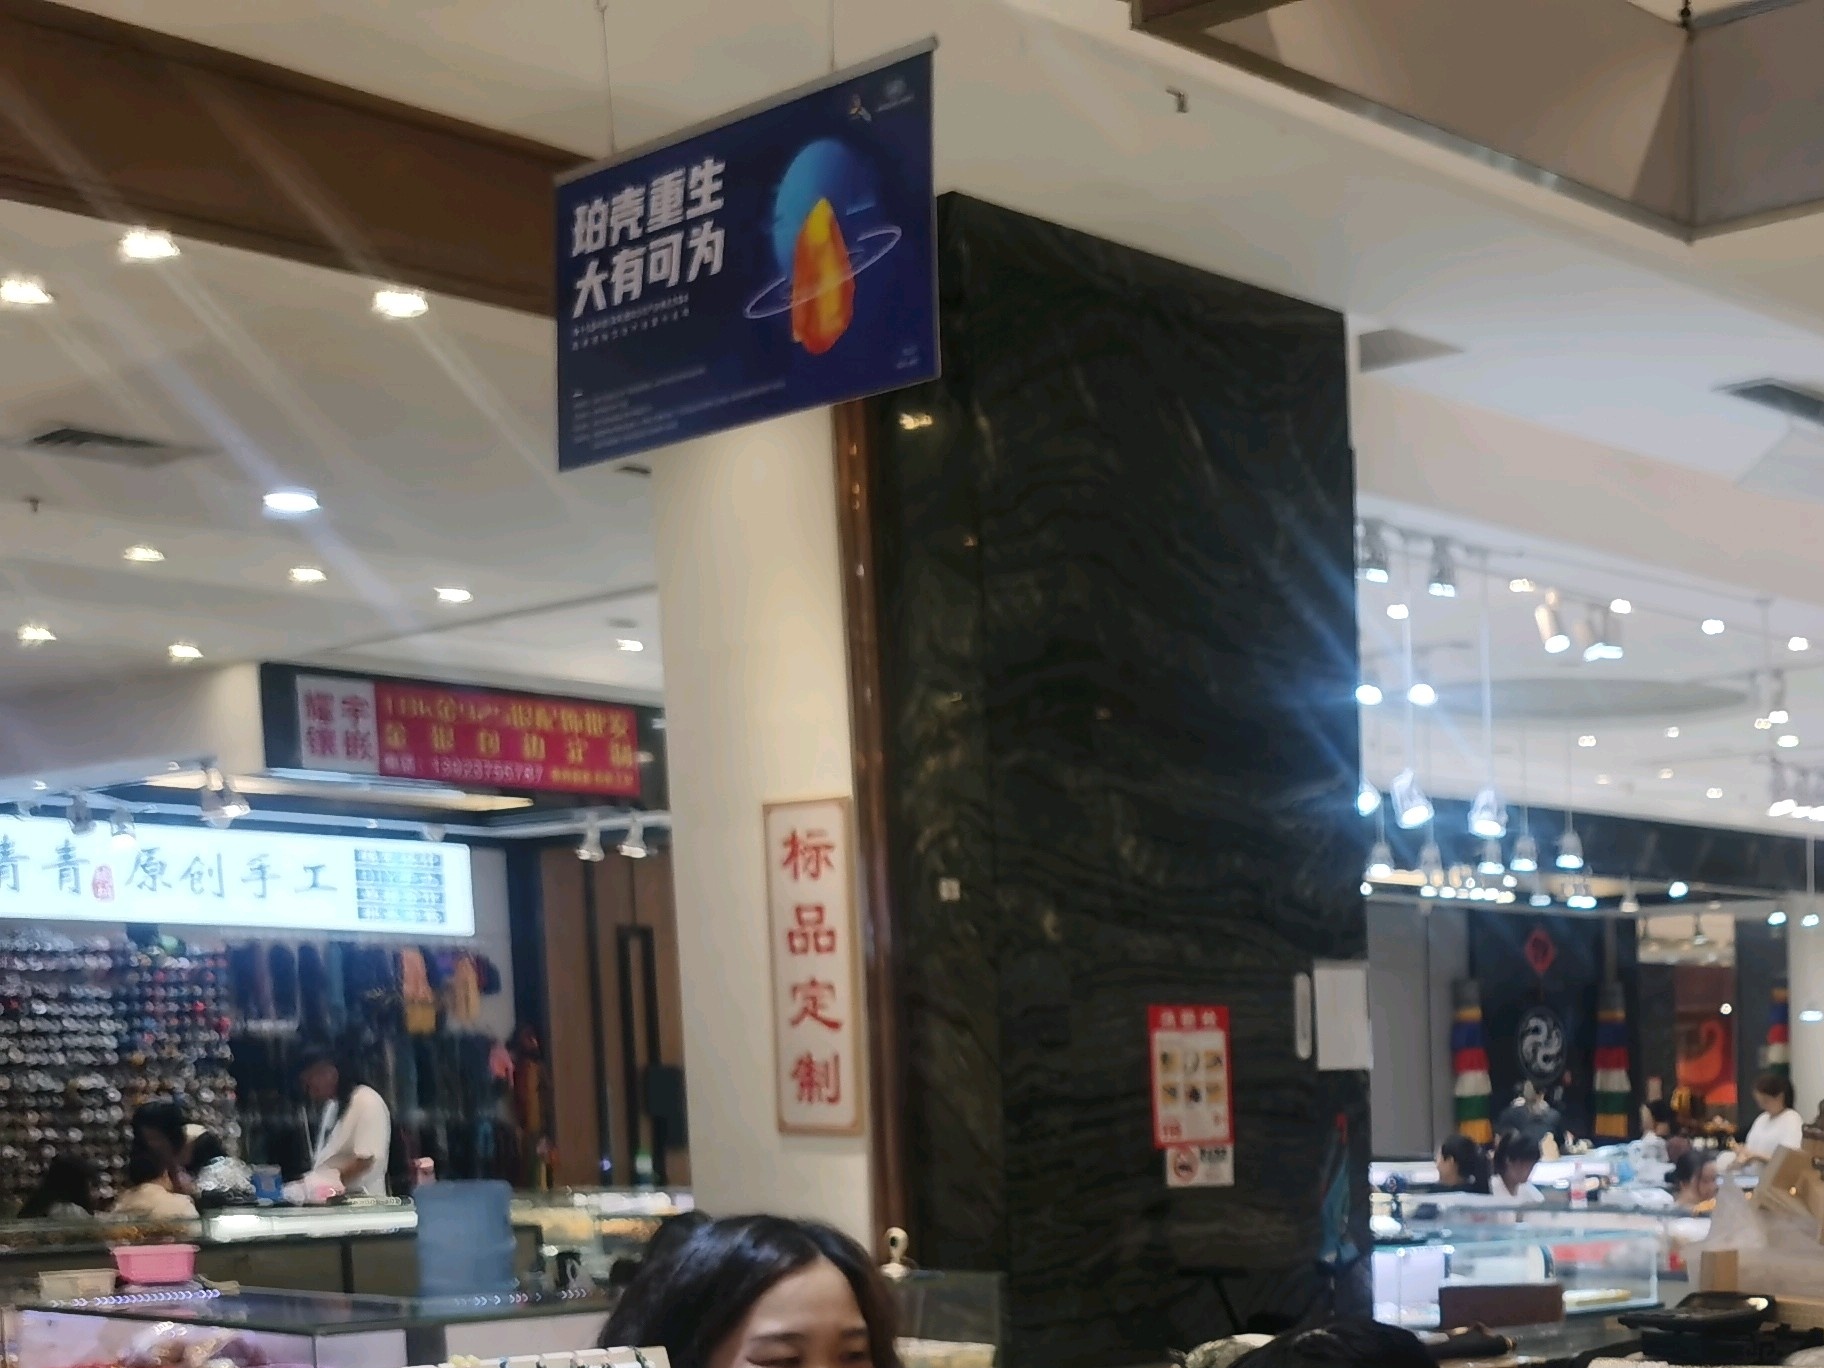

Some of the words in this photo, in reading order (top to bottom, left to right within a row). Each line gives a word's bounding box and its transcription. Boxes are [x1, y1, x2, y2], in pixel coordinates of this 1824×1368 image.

[571, 157, 726, 258] 珀壳重生
[573, 218, 725, 319] 大有可为
[126, 846, 338, 900] 原创手工
[781, 827, 843, 1105] 标品定制
